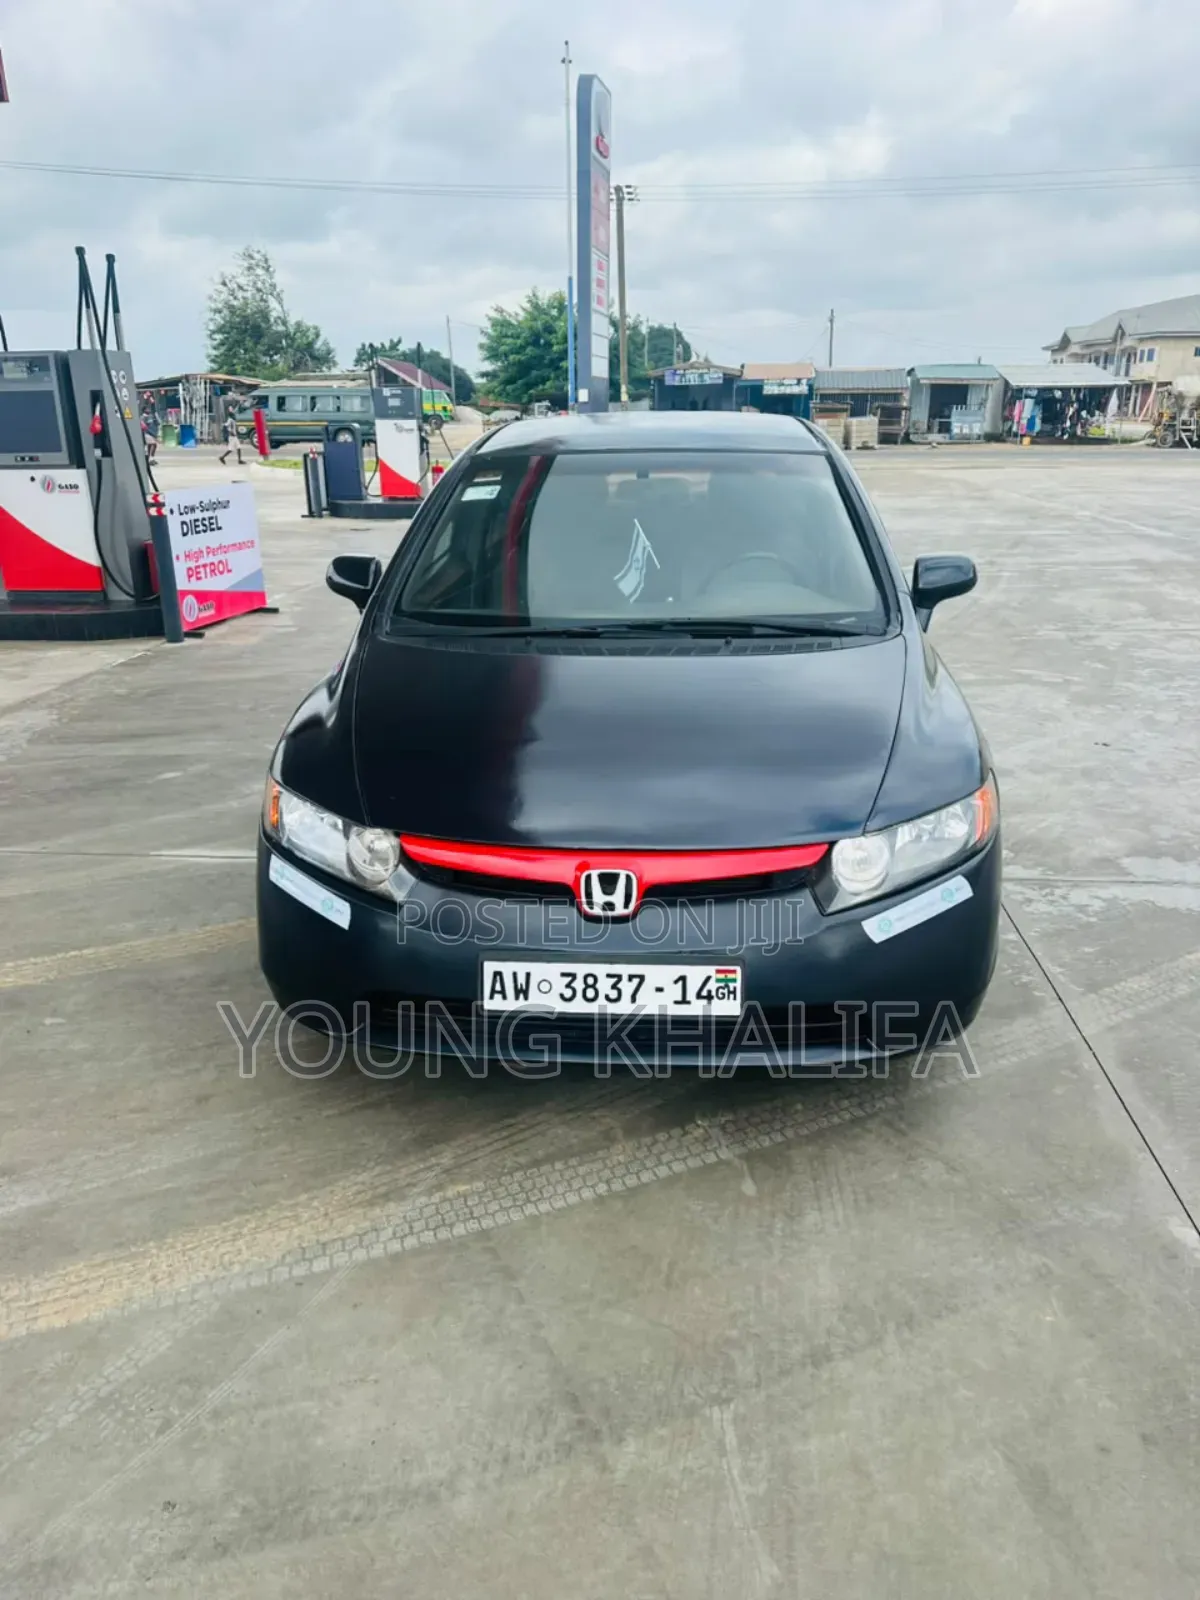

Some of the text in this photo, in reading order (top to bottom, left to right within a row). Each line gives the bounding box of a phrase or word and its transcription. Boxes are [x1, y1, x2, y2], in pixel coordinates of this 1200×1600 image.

[178, 499, 230, 516] Low-Sulphur
[180, 515, 222, 537] DIESEL
[184, 539, 255, 564] High Performance
[186, 559, 232, 583] PETROL
[488, 970, 531, 1001] AW
